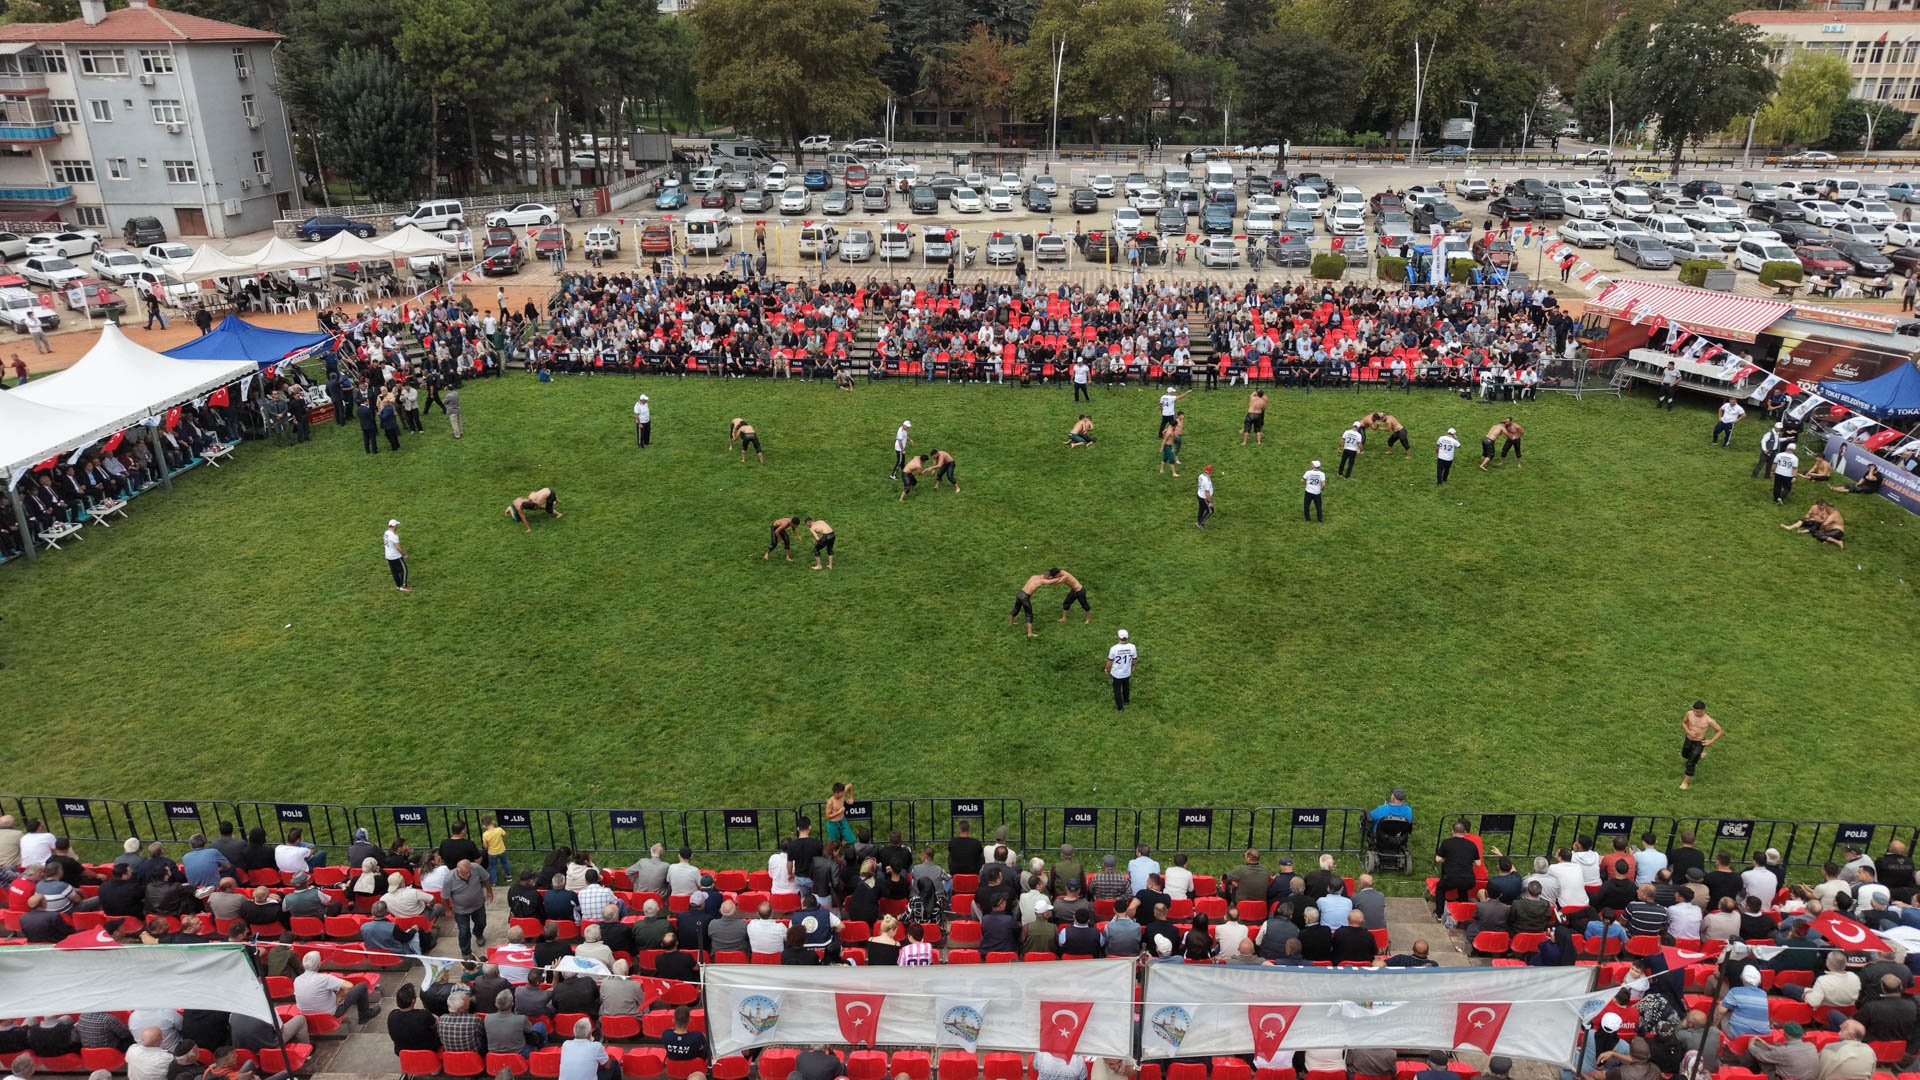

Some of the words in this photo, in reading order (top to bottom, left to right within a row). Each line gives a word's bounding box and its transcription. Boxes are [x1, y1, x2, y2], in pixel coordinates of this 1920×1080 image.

[1796, 381, 1820, 394] TOK
[1825, 389, 1841, 401] TOKAT
[64, 803, 85, 811] POLİS
[173, 806, 194, 814] POLİS
[957, 803, 978, 812] POLİS
[282, 809, 303, 818] POLİS
[399, 812, 421, 821] POLİS
[730, 815, 752, 824] POLİS
[1185, 814, 1207, 823] POLİS
[1298, 814, 1320, 823] POLİS
[1603, 822, 1625, 830] POLS
[1844, 829, 1868, 838] POLİS
